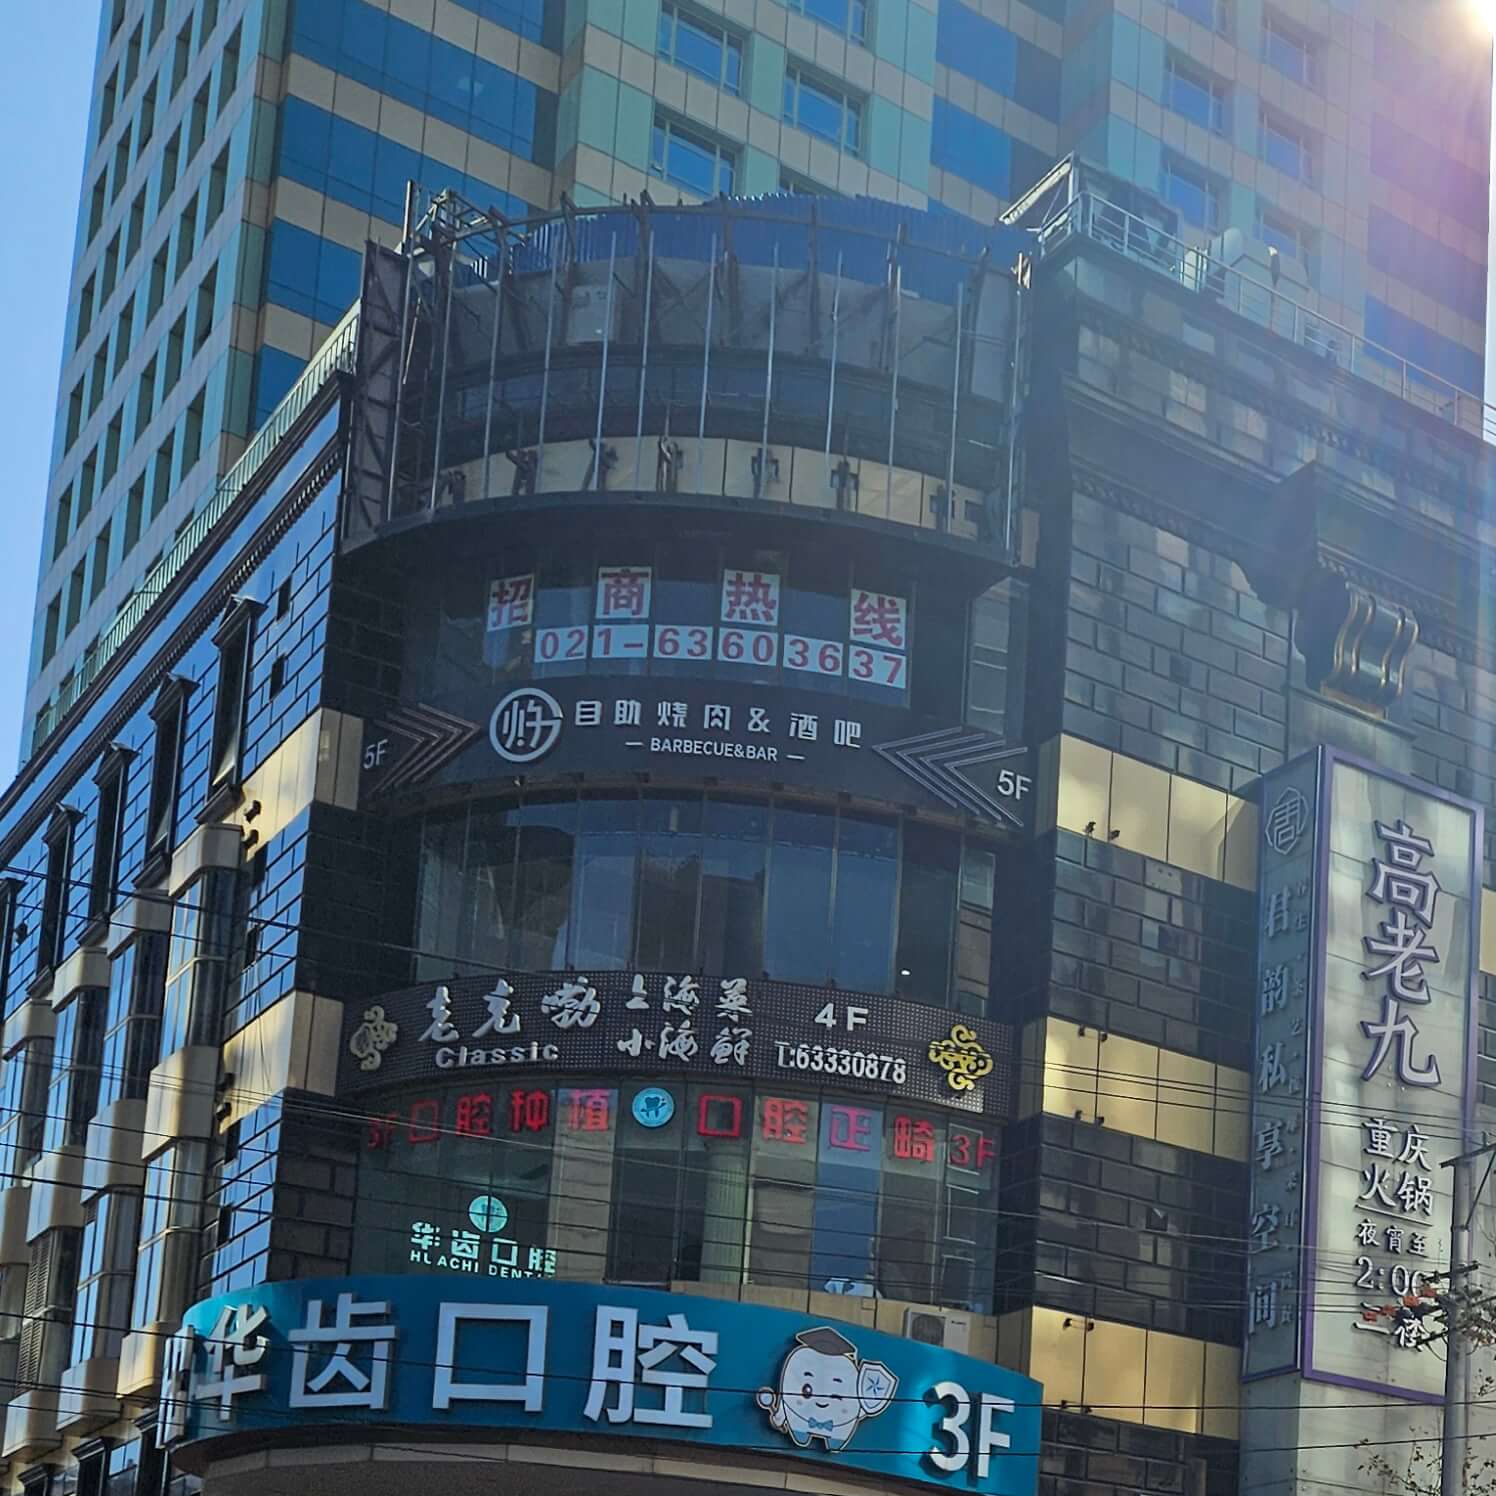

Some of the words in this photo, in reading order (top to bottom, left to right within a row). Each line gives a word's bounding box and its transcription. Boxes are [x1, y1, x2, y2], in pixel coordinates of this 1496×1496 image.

[490, 567, 905, 647] 招商热线
[540, 625, 904, 688] 021-63603637
[363, 742, 388, 770] 5F
[649, 736, 779, 763] BARBECUE&BAR
[996, 769, 1032, 800] 5F
[1361, 819, 1443, 1087] 高老九
[814, 1002, 870, 1033] 4F
[435, 1040, 560, 1069] Classic
[697, 1093, 935, 1163] 口腔正畸
[1359, 1117, 1431, 1173] 重庆
[1359, 1162, 1434, 1215] 火锅
[1356, 1218, 1429, 1260] 夜宵至
[195, 1292, 721, 1430] 华齿口腔
[921, 1380, 1017, 1482] 3F
